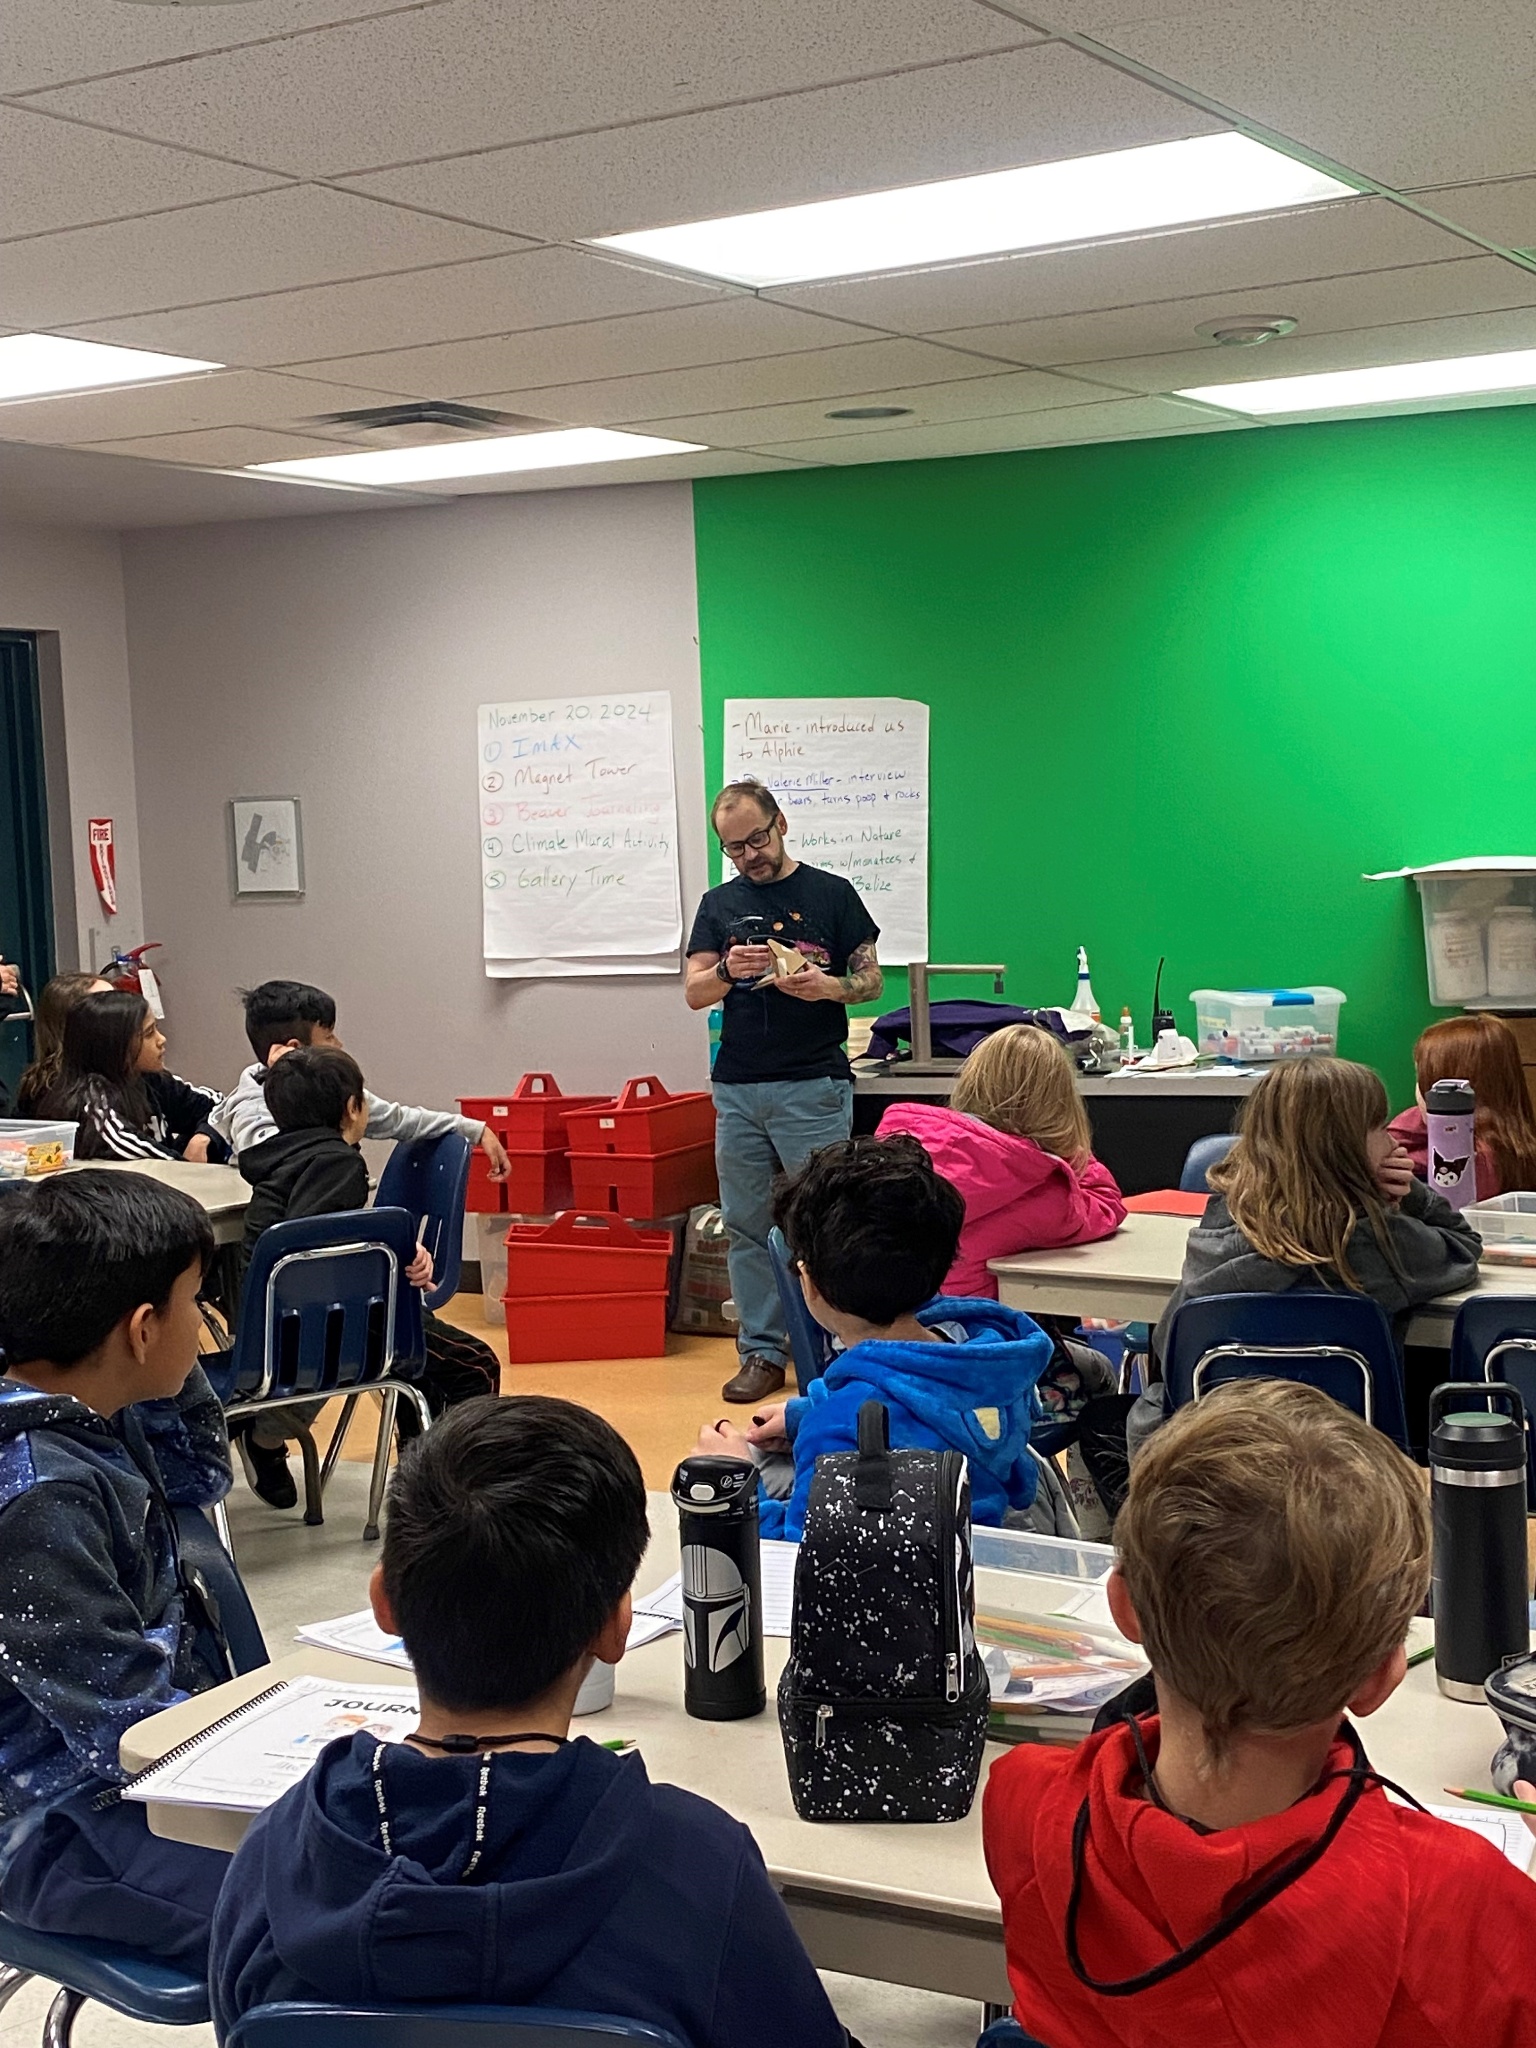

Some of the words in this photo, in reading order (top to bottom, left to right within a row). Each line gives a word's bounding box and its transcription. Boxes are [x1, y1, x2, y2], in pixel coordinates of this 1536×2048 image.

[489, 709, 556, 729] November
[600, 704, 652, 722] 2024
[806, 714, 875, 735] introduced
[884, 719, 905, 734] us
[738, 747, 753, 761] to
[761, 741, 805, 763] Alphie
[514, 764, 573, 795] Magnet
[584, 757, 638, 780] Tower
[768, 773, 801, 789] Valerie
[848, 770, 907, 785] interview
[821, 791, 851, 805] turns
[855, 793, 876, 809] poop
[895, 787, 921, 800] rocks
[515, 802, 571, 823] Beaver
[93, 828, 110, 841] FIRE
[511, 829, 569, 854] Climate
[575, 828, 615, 850] Mural
[624, 827, 671, 858] Activity
[801, 833, 837, 848] Works
[840, 833, 853, 843] in
[861, 825, 901, 842] Nature
[518, 864, 578, 897] Gallery
[584, 864, 627, 886] Time
[324, 1698, 421, 1715] JOURN
[479, 1766, 491, 1797] Reebok
[374, 1779, 388, 1814] Reebok
[475, 1806, 487, 1842] Reebok
